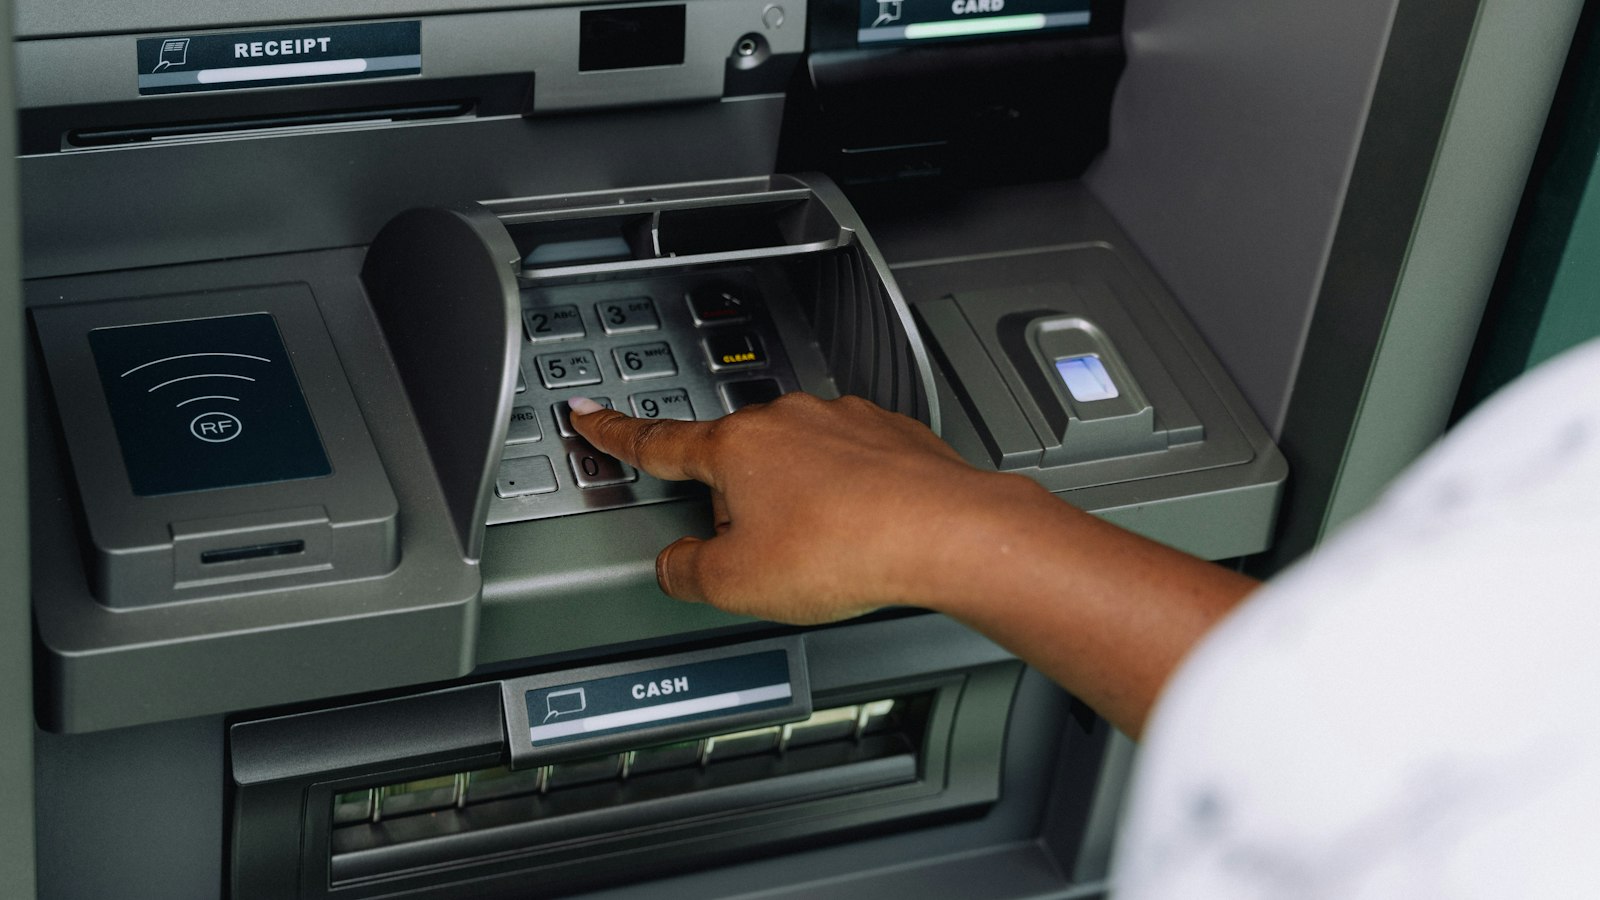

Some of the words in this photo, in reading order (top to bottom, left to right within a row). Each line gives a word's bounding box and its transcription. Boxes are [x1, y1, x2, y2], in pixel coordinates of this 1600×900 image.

[951, 0, 1005, 15] CARD
[234, 37, 331, 58] RECEIPT
[531, 313, 552, 333] 2
[553, 310, 577, 320] ABC
[607, 305, 627, 325] 3
[548, 359, 567, 379] 5
[569, 356, 590, 366] JKL
[624, 351, 644, 371] 6
[722, 352, 756, 364] CLEAR
[641, 398, 660, 418] 9
[661, 395, 688, 405] WXY
[200, 420, 232, 435] RF
[581, 456, 599, 477] 0
[631, 676, 689, 700] CASH
